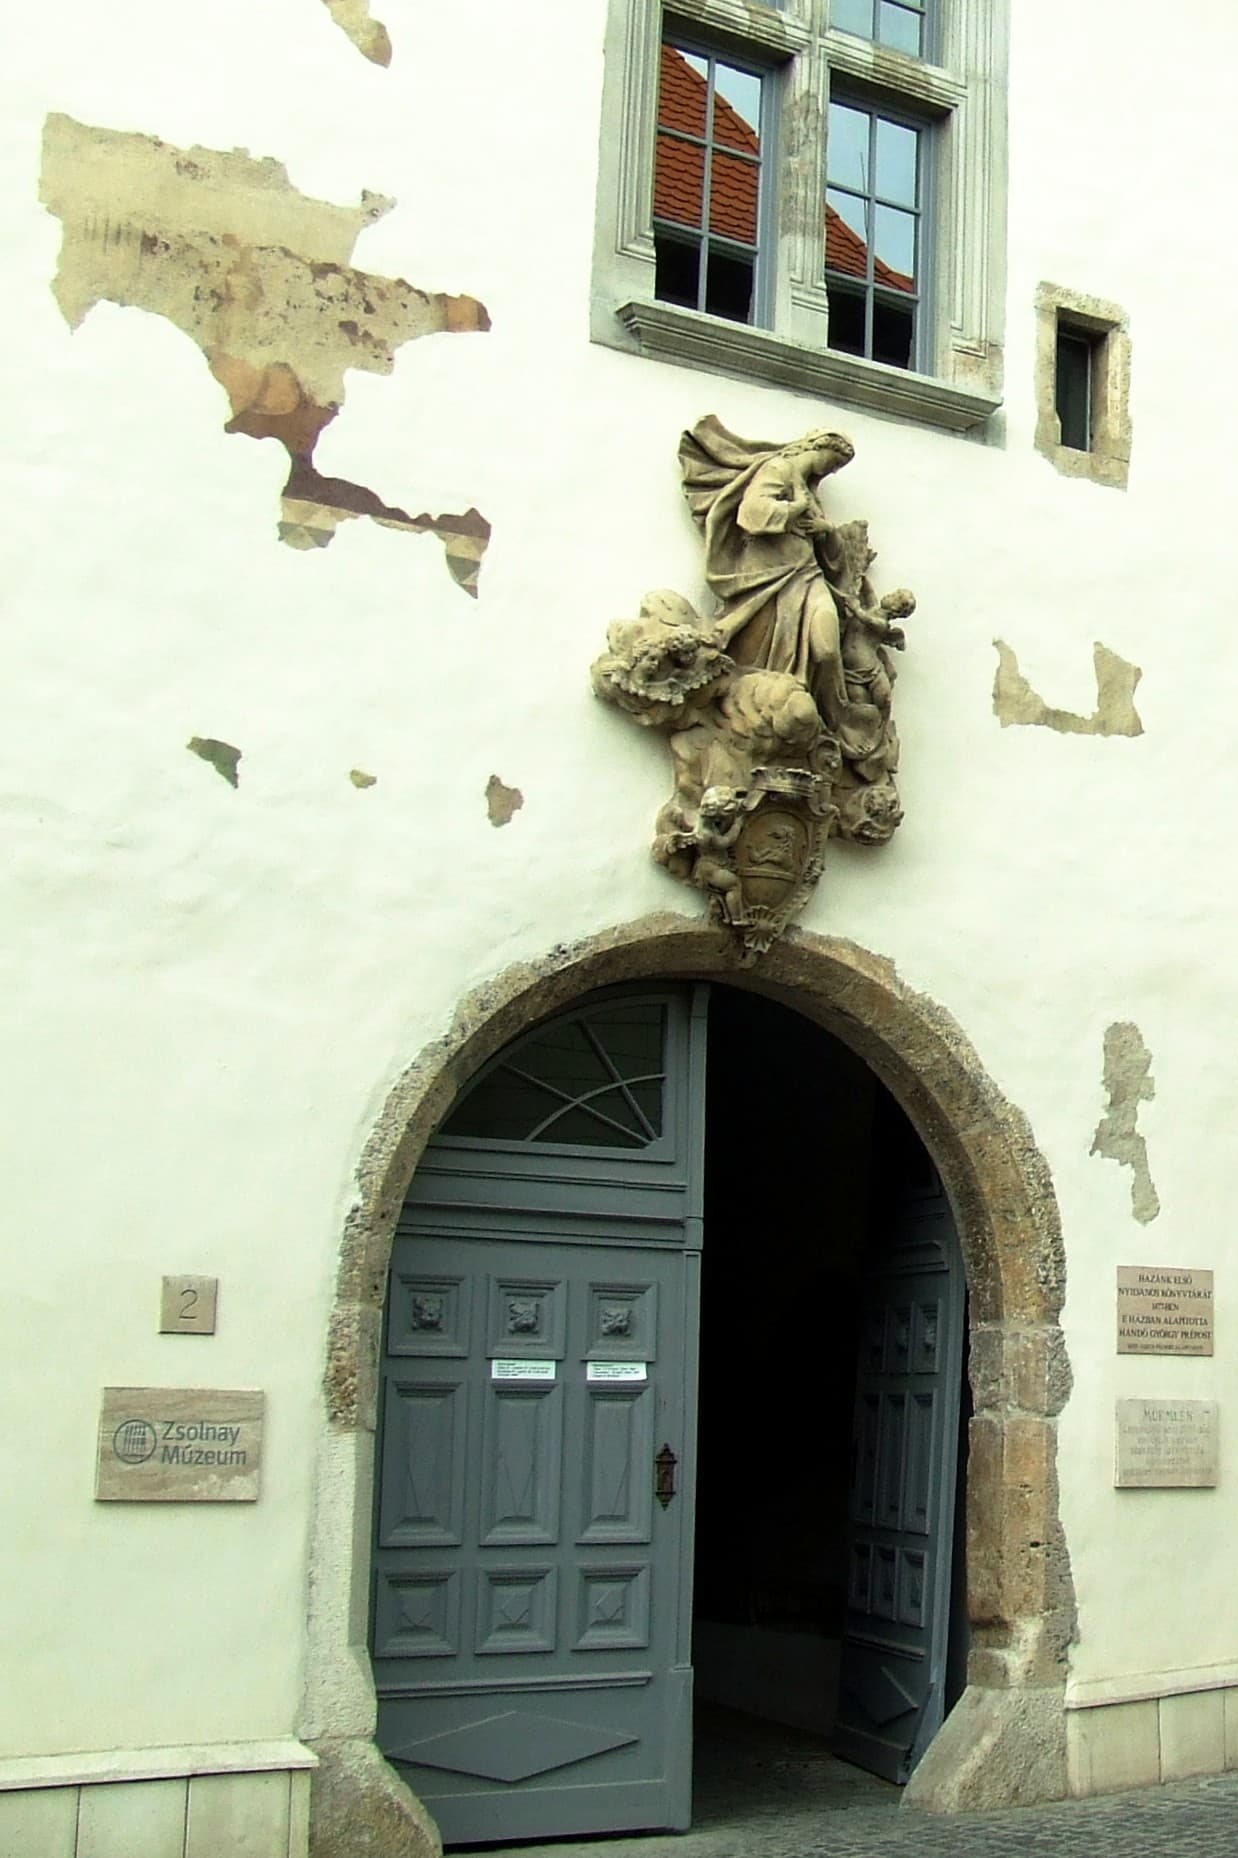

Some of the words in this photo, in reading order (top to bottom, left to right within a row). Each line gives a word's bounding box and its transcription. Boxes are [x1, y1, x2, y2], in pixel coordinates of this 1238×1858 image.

[179, 1288, 198, 1319] 2
[161, 1420, 240, 1446] Zsolnay
[161, 1443, 247, 1465] Múzeum
